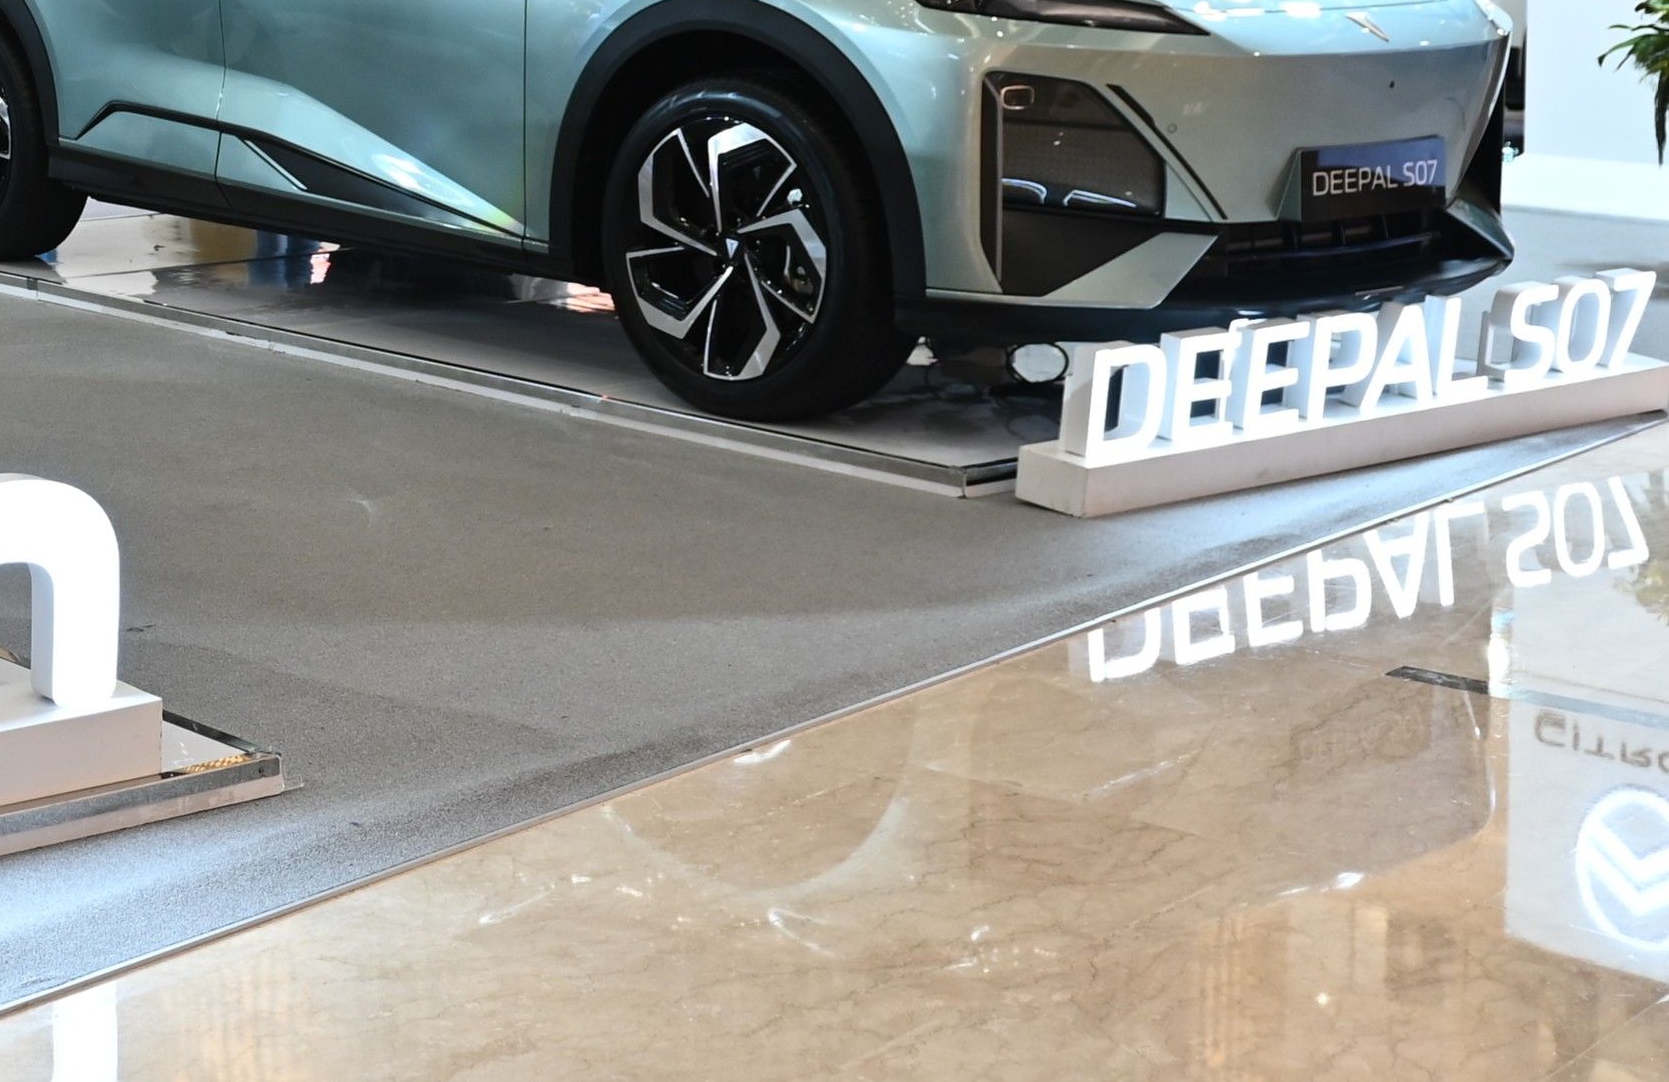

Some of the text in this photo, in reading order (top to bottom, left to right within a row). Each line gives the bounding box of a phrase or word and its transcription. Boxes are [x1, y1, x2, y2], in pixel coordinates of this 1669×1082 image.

[1312, 159, 1438, 197] DEEPAL S07
[1082, 269, 1657, 460] DEEPAL S07
